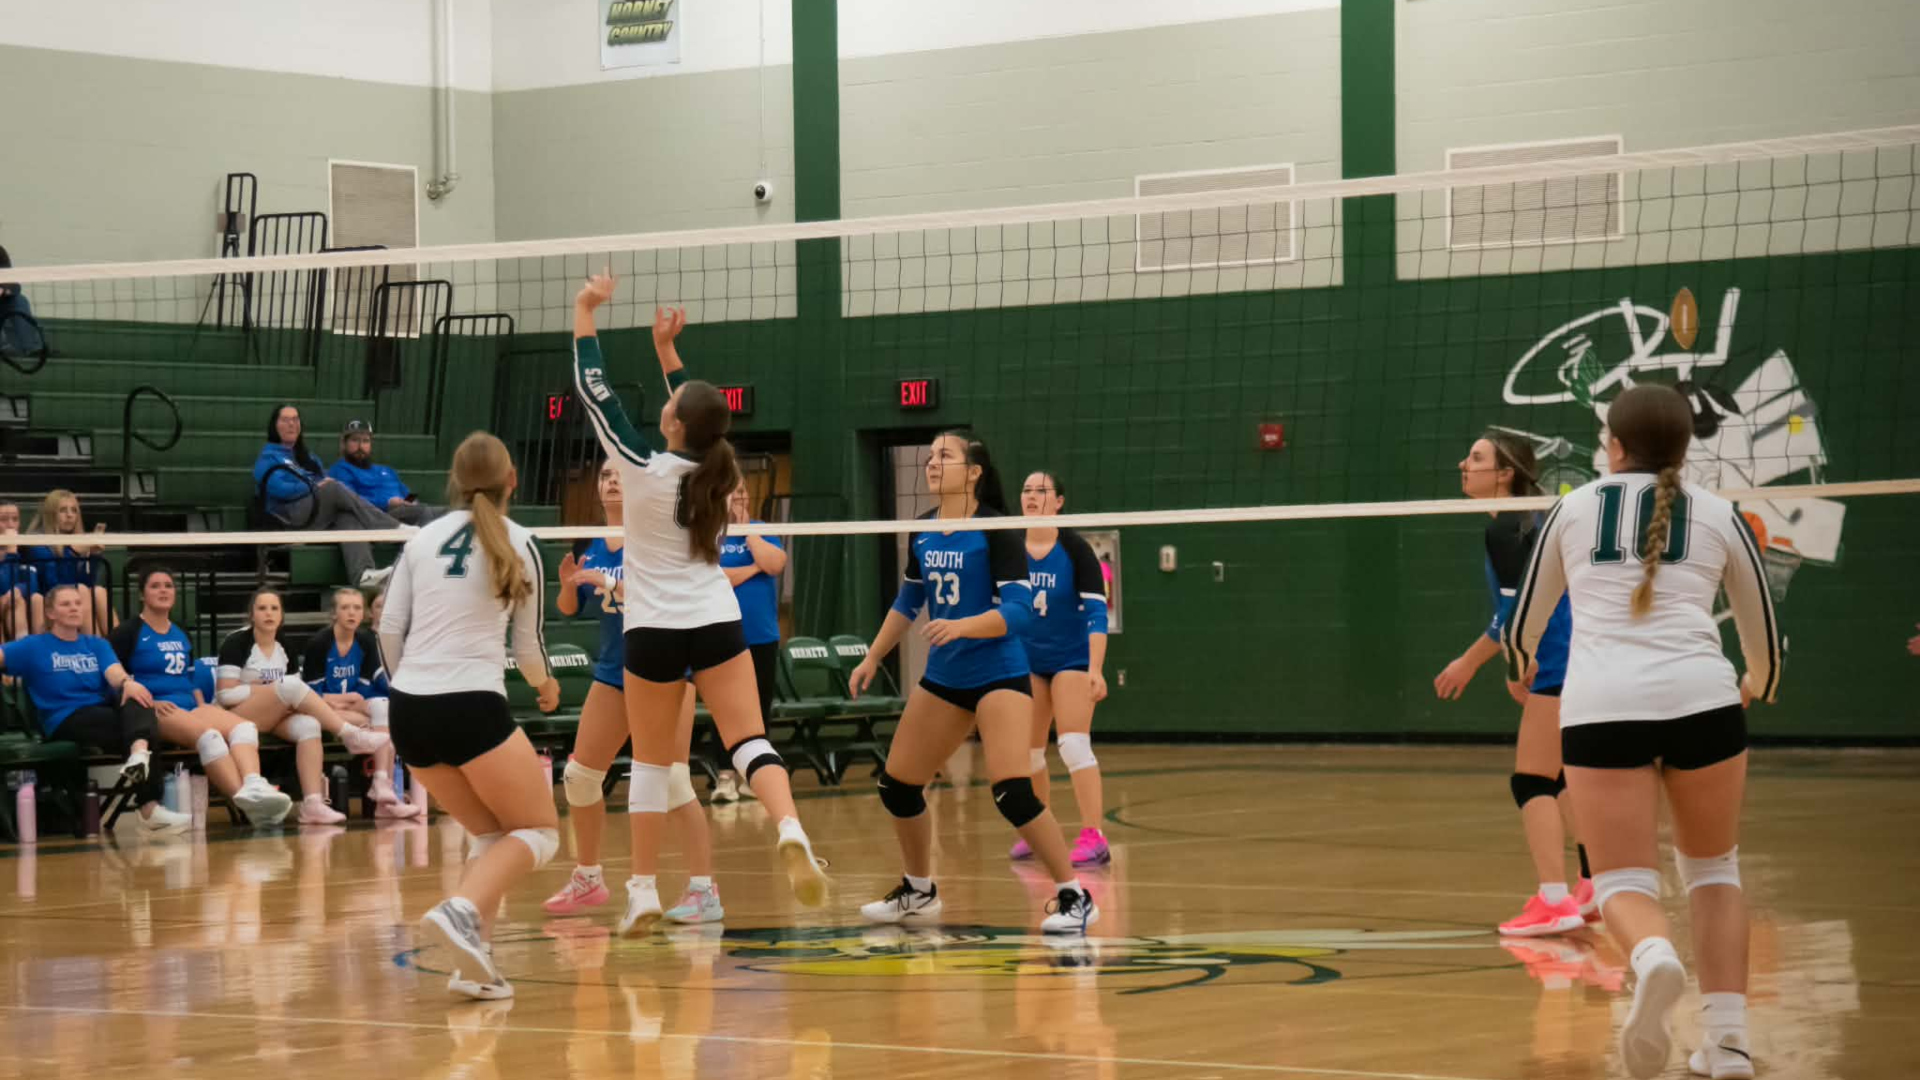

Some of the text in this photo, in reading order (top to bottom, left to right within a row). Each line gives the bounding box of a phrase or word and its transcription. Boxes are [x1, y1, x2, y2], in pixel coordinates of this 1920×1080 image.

[607, 21, 673, 46] COUNTRY
[720, 388, 743, 412] XIT
[901, 381, 927, 405] EXIT
[1591, 482, 1693, 565] 10
[436, 520, 477, 578] 4
[924, 550, 963, 569] SOUTH
[928, 571, 960, 605] 23
[1029, 572, 1056, 588] UTH
[1033, 590, 1048, 616] 4
[157, 641, 184, 652] SOUTH
[164, 652, 186, 675] 26
